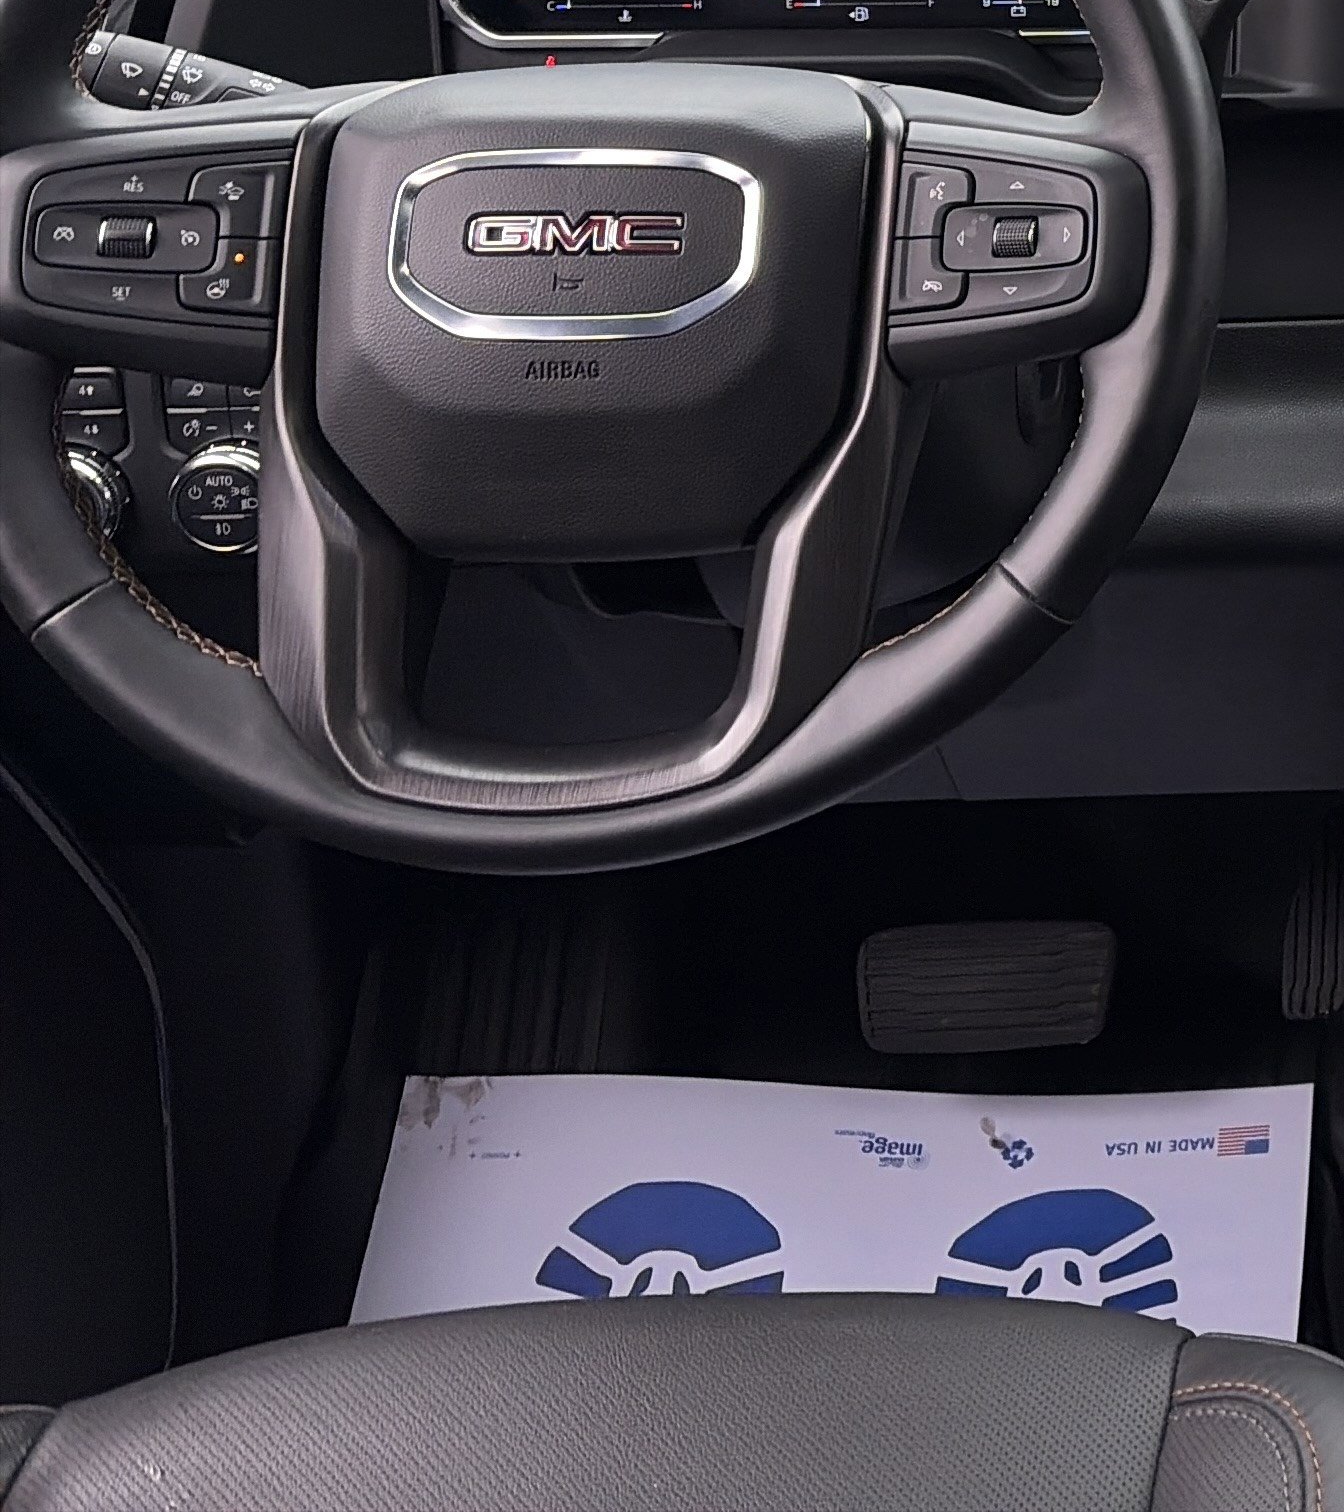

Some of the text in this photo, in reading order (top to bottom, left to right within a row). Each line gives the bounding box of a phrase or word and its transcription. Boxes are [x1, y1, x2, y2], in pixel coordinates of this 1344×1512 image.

[547, 1, 555, 11] C
[693, 1, 702, 10] H
[786, 0, 793, 9] E
[170, 91, 191, 104] OFF
[123, 182, 144, 193] RES
[464, 211, 685, 256] GMC
[112, 286, 131, 298] SET
[525, 360, 600, 379] AIRBAG
[206, 476, 233, 486] AUTO
[1106, 1137, 1214, 1156] MADE IN USA
